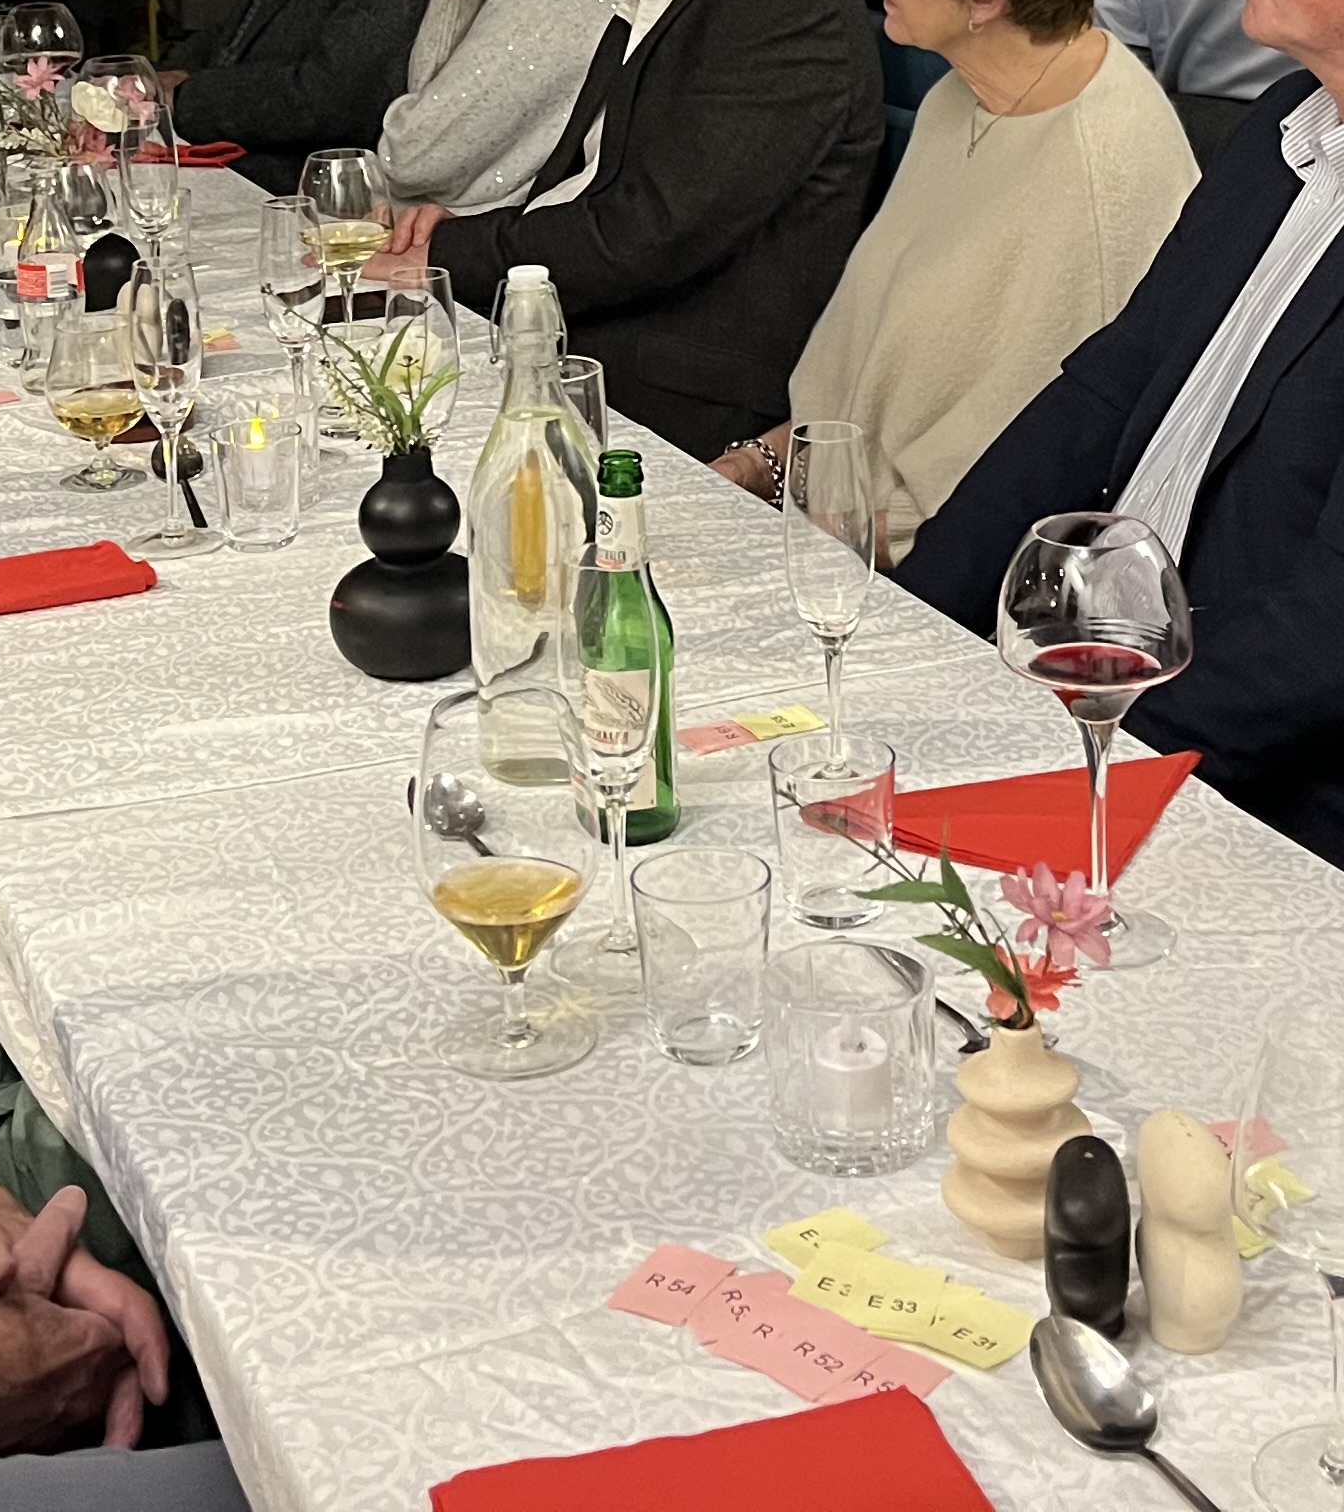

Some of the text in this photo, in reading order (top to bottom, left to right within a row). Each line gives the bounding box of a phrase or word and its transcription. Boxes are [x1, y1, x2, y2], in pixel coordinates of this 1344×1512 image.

[645, 1272, 697, 1296] R 54
[816, 1276, 836, 1292] E
[721, 1289, 751, 1322] R 5
[867, 1294, 918, 1314] E 33
[752, 1323, 774, 1339] R
[951, 1327, 974, 1340] E
[792, 1341, 844, 1373] R 52
[852, 1370, 875, 1387] R
